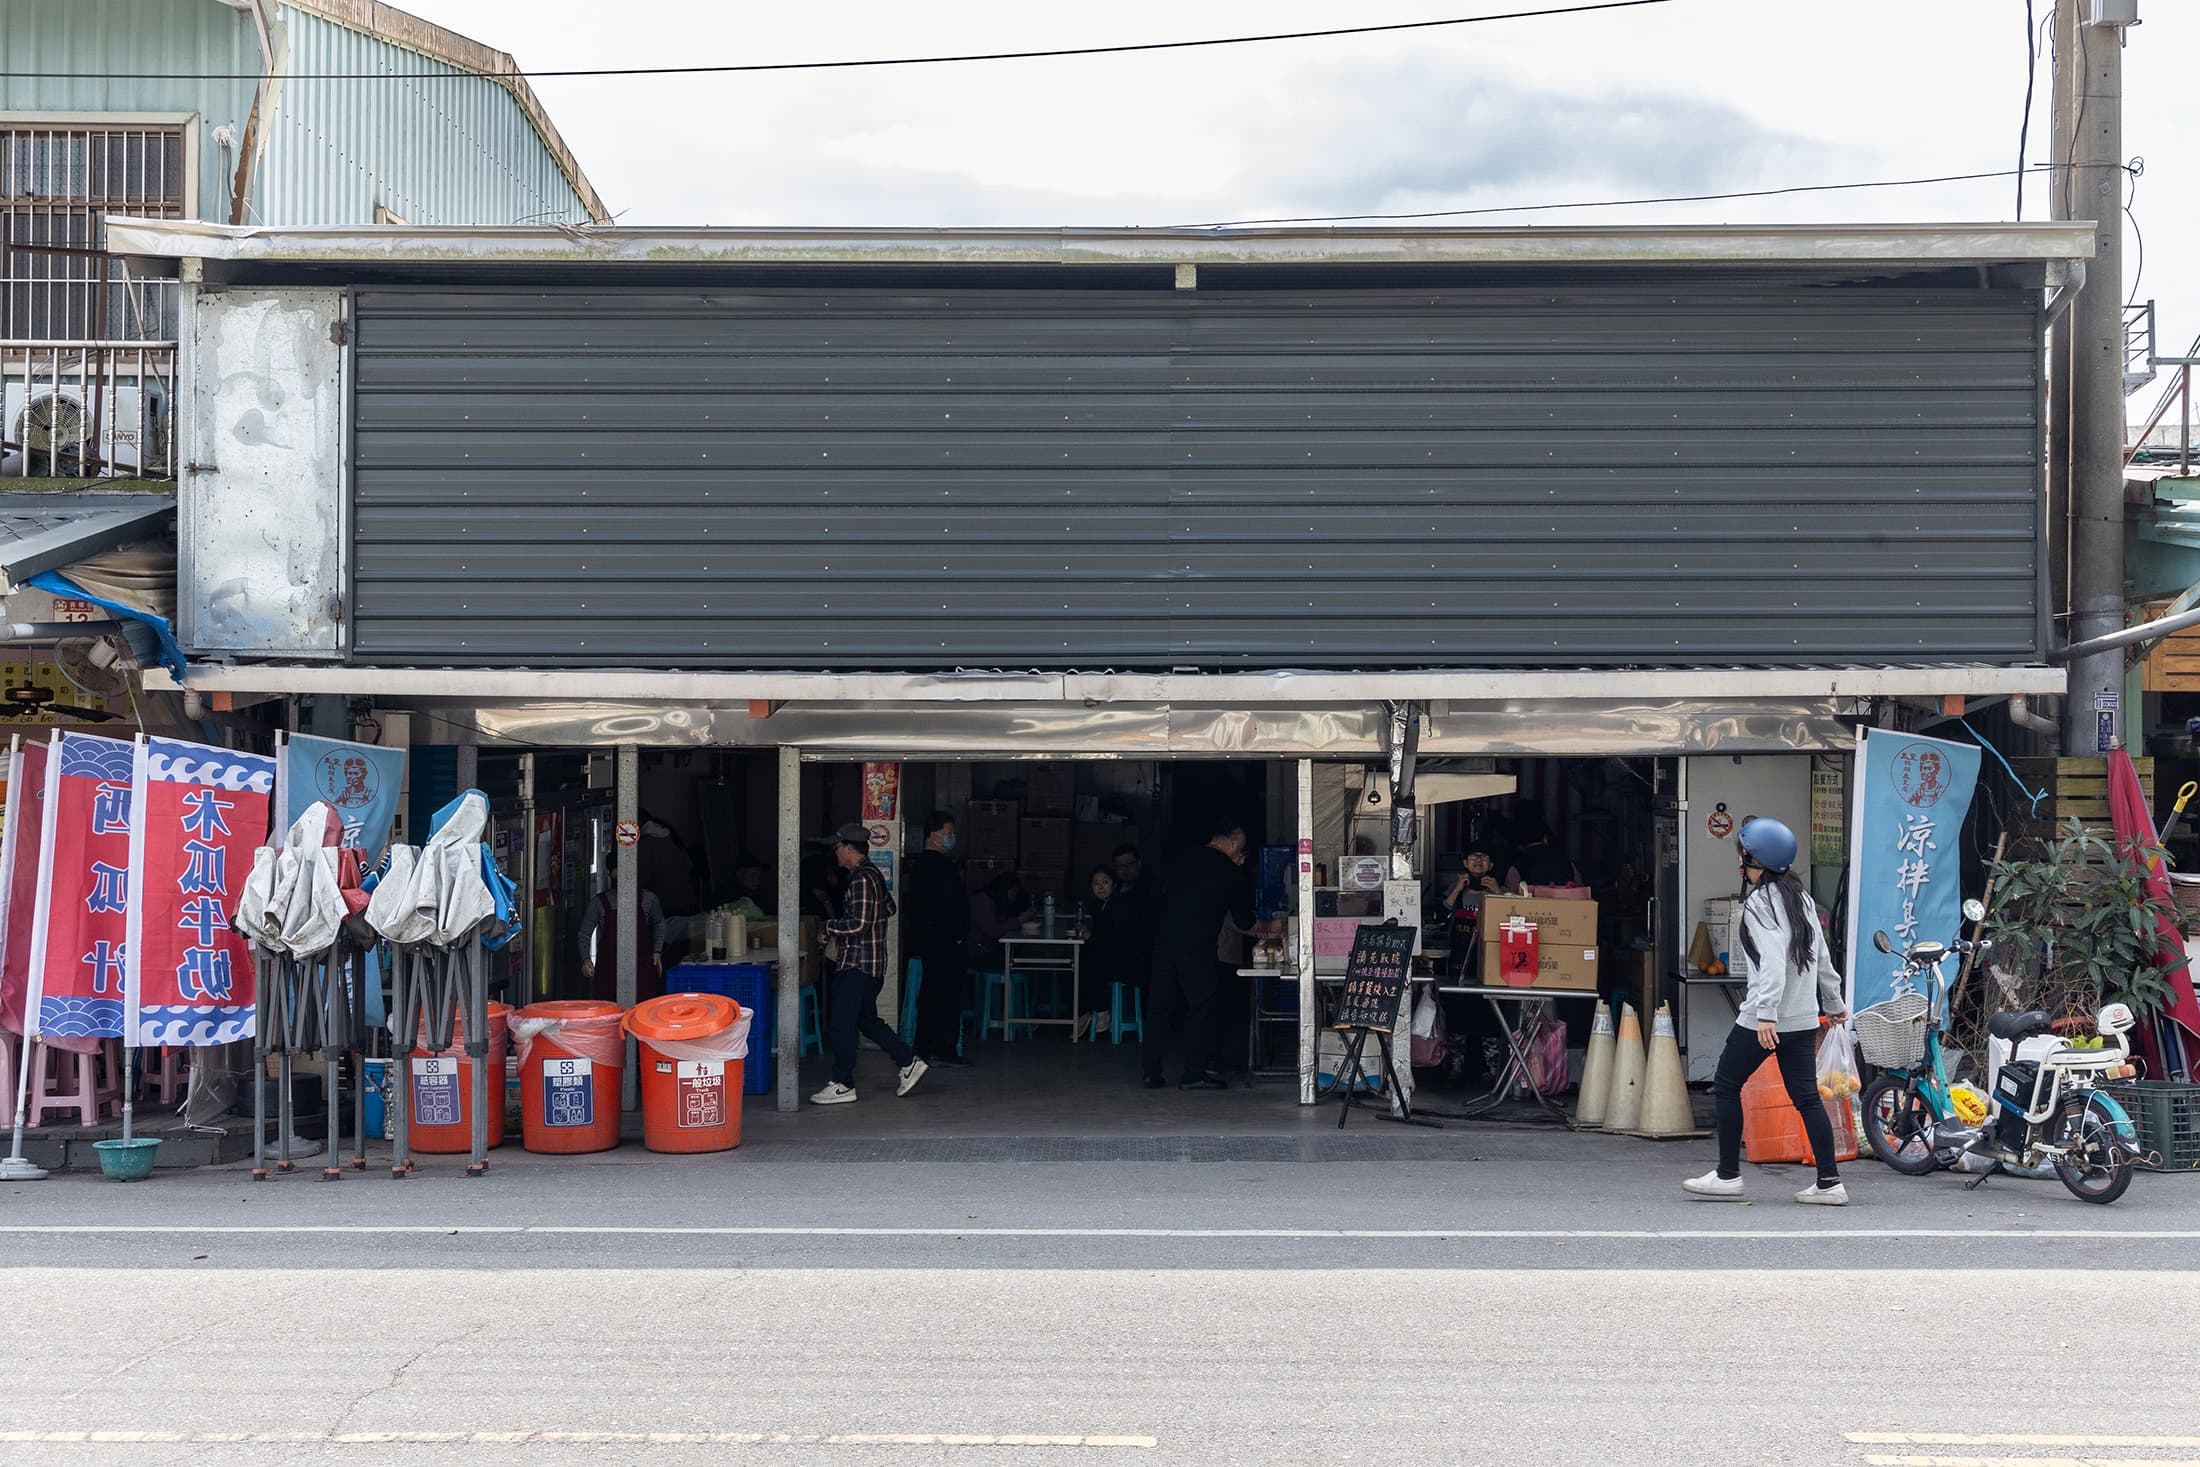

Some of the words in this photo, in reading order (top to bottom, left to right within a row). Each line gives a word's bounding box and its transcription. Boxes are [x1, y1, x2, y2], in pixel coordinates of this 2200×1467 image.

[1889, 814, 1937, 1001] 涼拌臭
[420, 1075, 448, 1086] 紙容器
[682, 1076, 721, 1088] 一般垃圾
